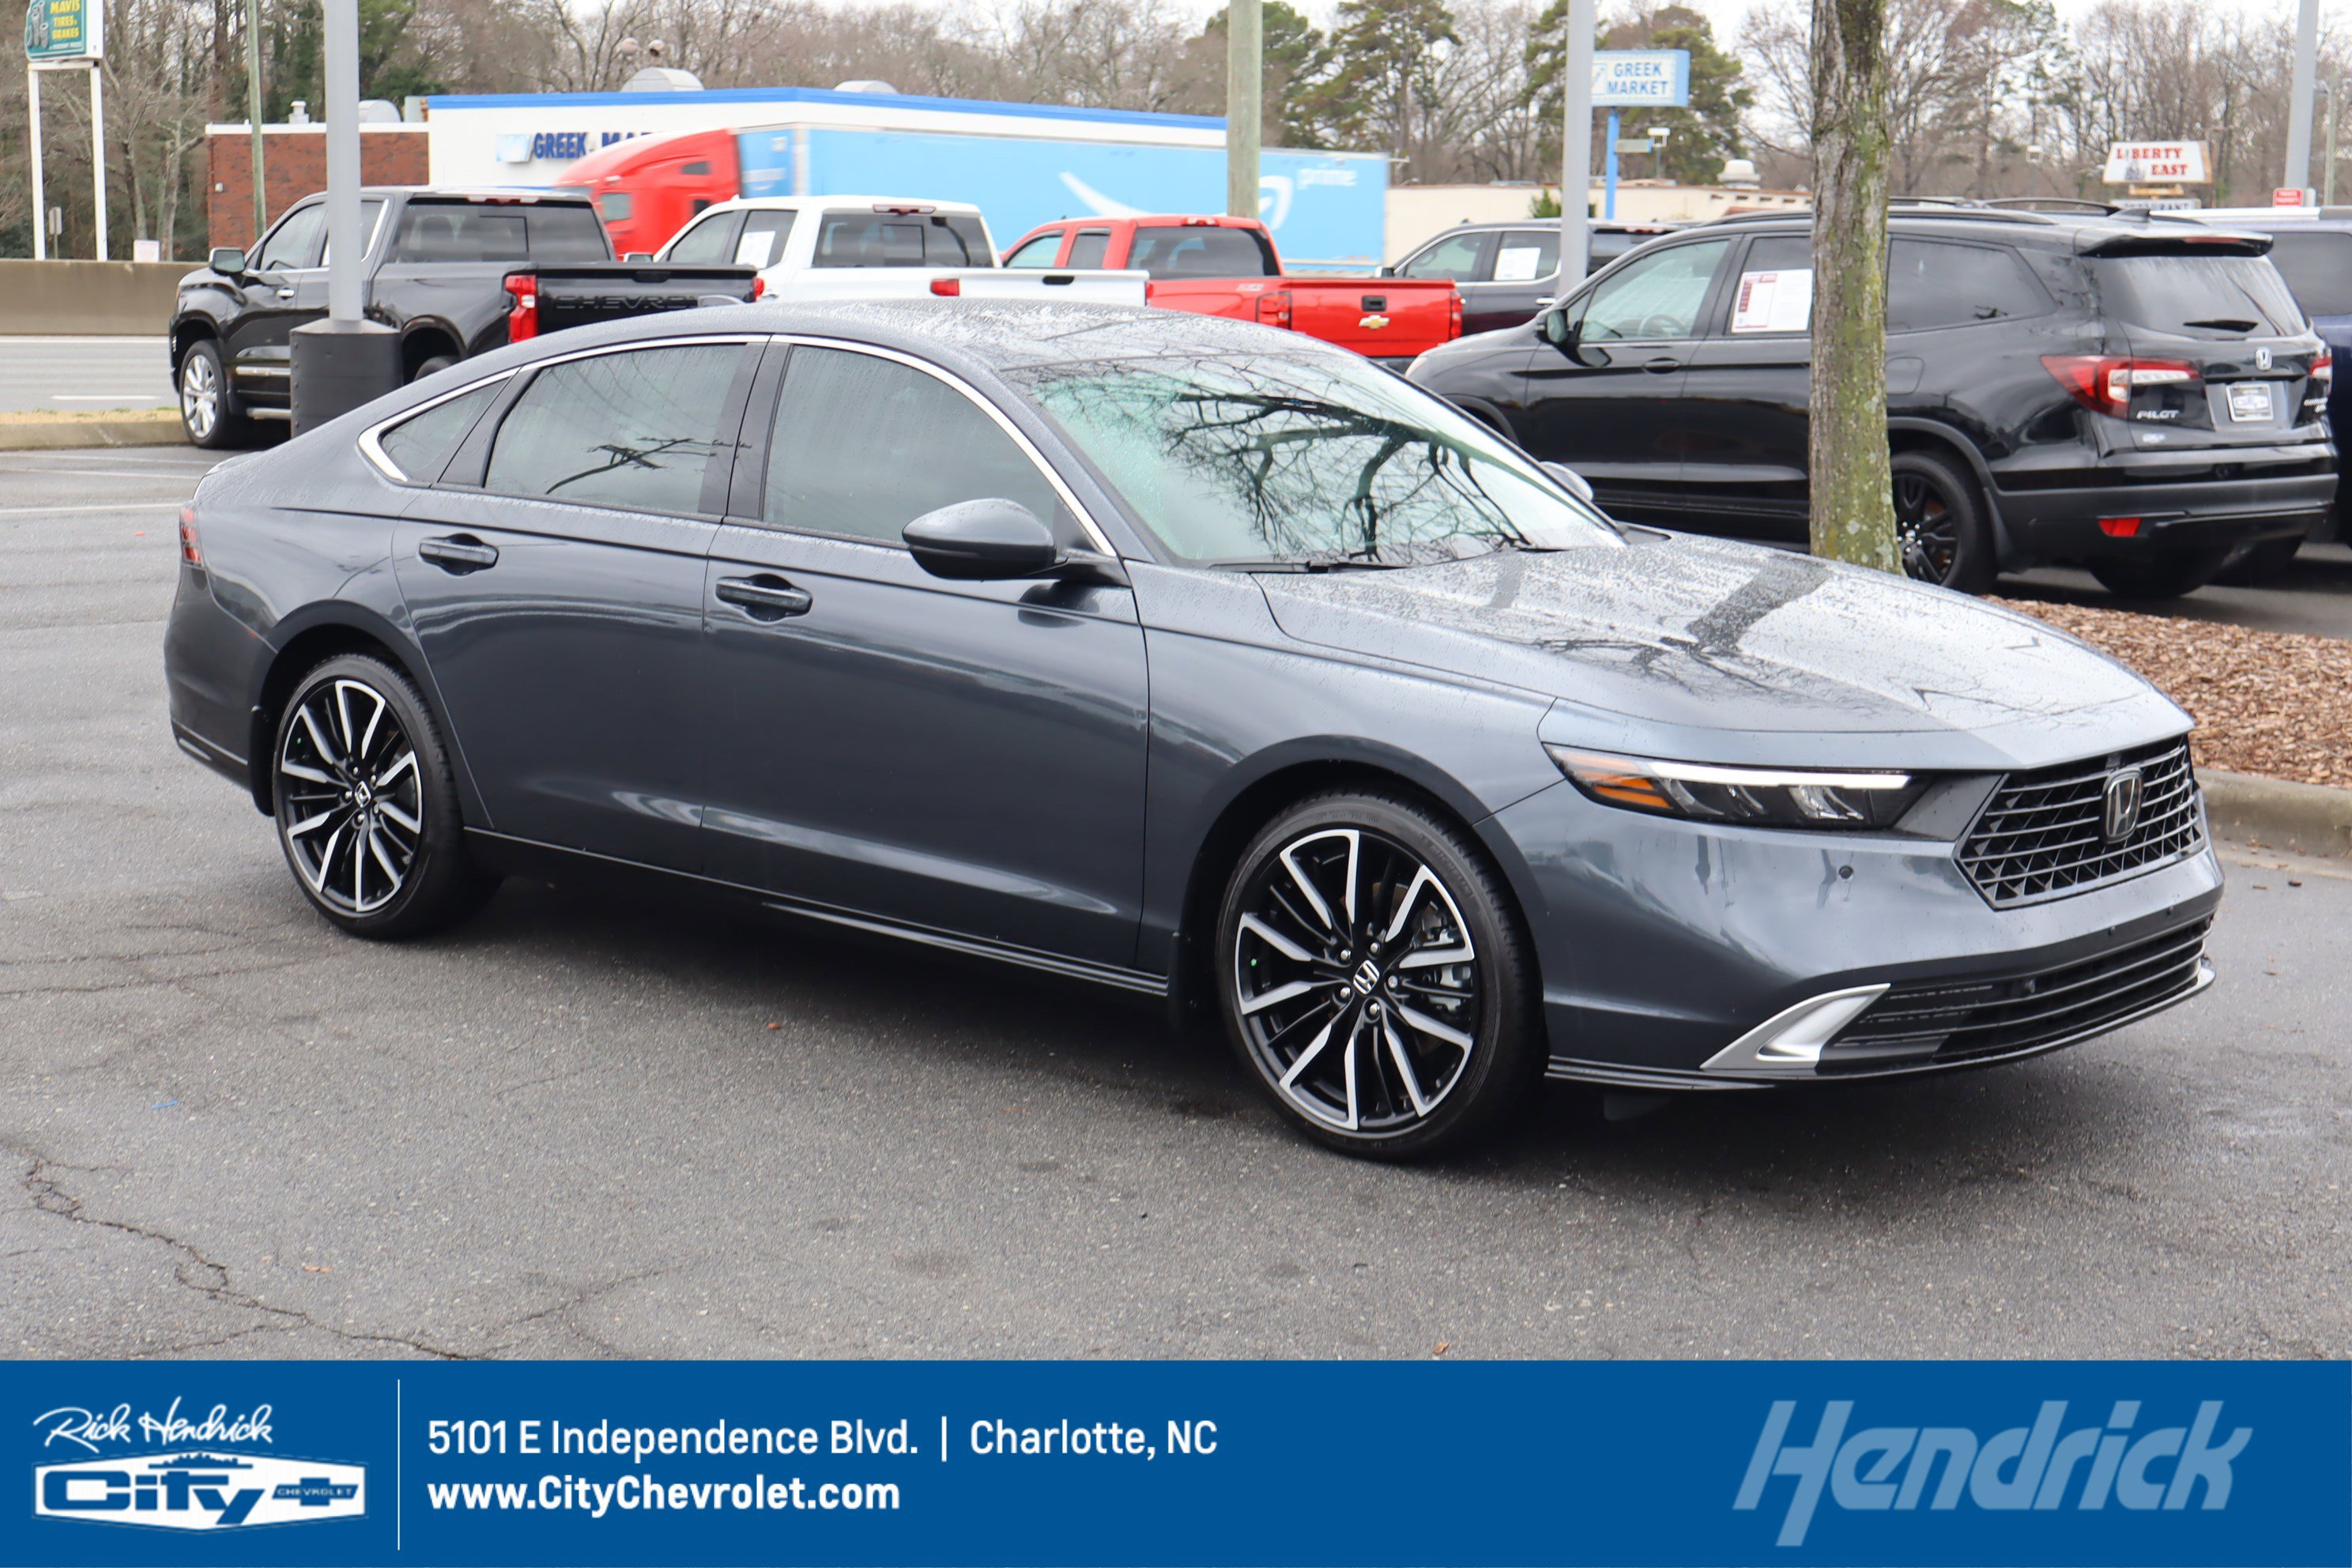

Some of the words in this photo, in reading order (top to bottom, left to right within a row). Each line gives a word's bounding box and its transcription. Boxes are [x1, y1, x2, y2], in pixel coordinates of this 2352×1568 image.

[51, 0, 80, 14] MAVIS
[52, 27, 79, 40] BRAKES
[1614, 62, 1662, 77] GREEK
[1608, 81, 1668, 95] MARKET
[533, 131, 588, 160] GREEK
[1296, 163, 1358, 190] prime
[2151, 164, 2188, 175] EAST
[555, 295, 697, 310] CHEVRO
[2135, 409, 2180, 420] PILOT
